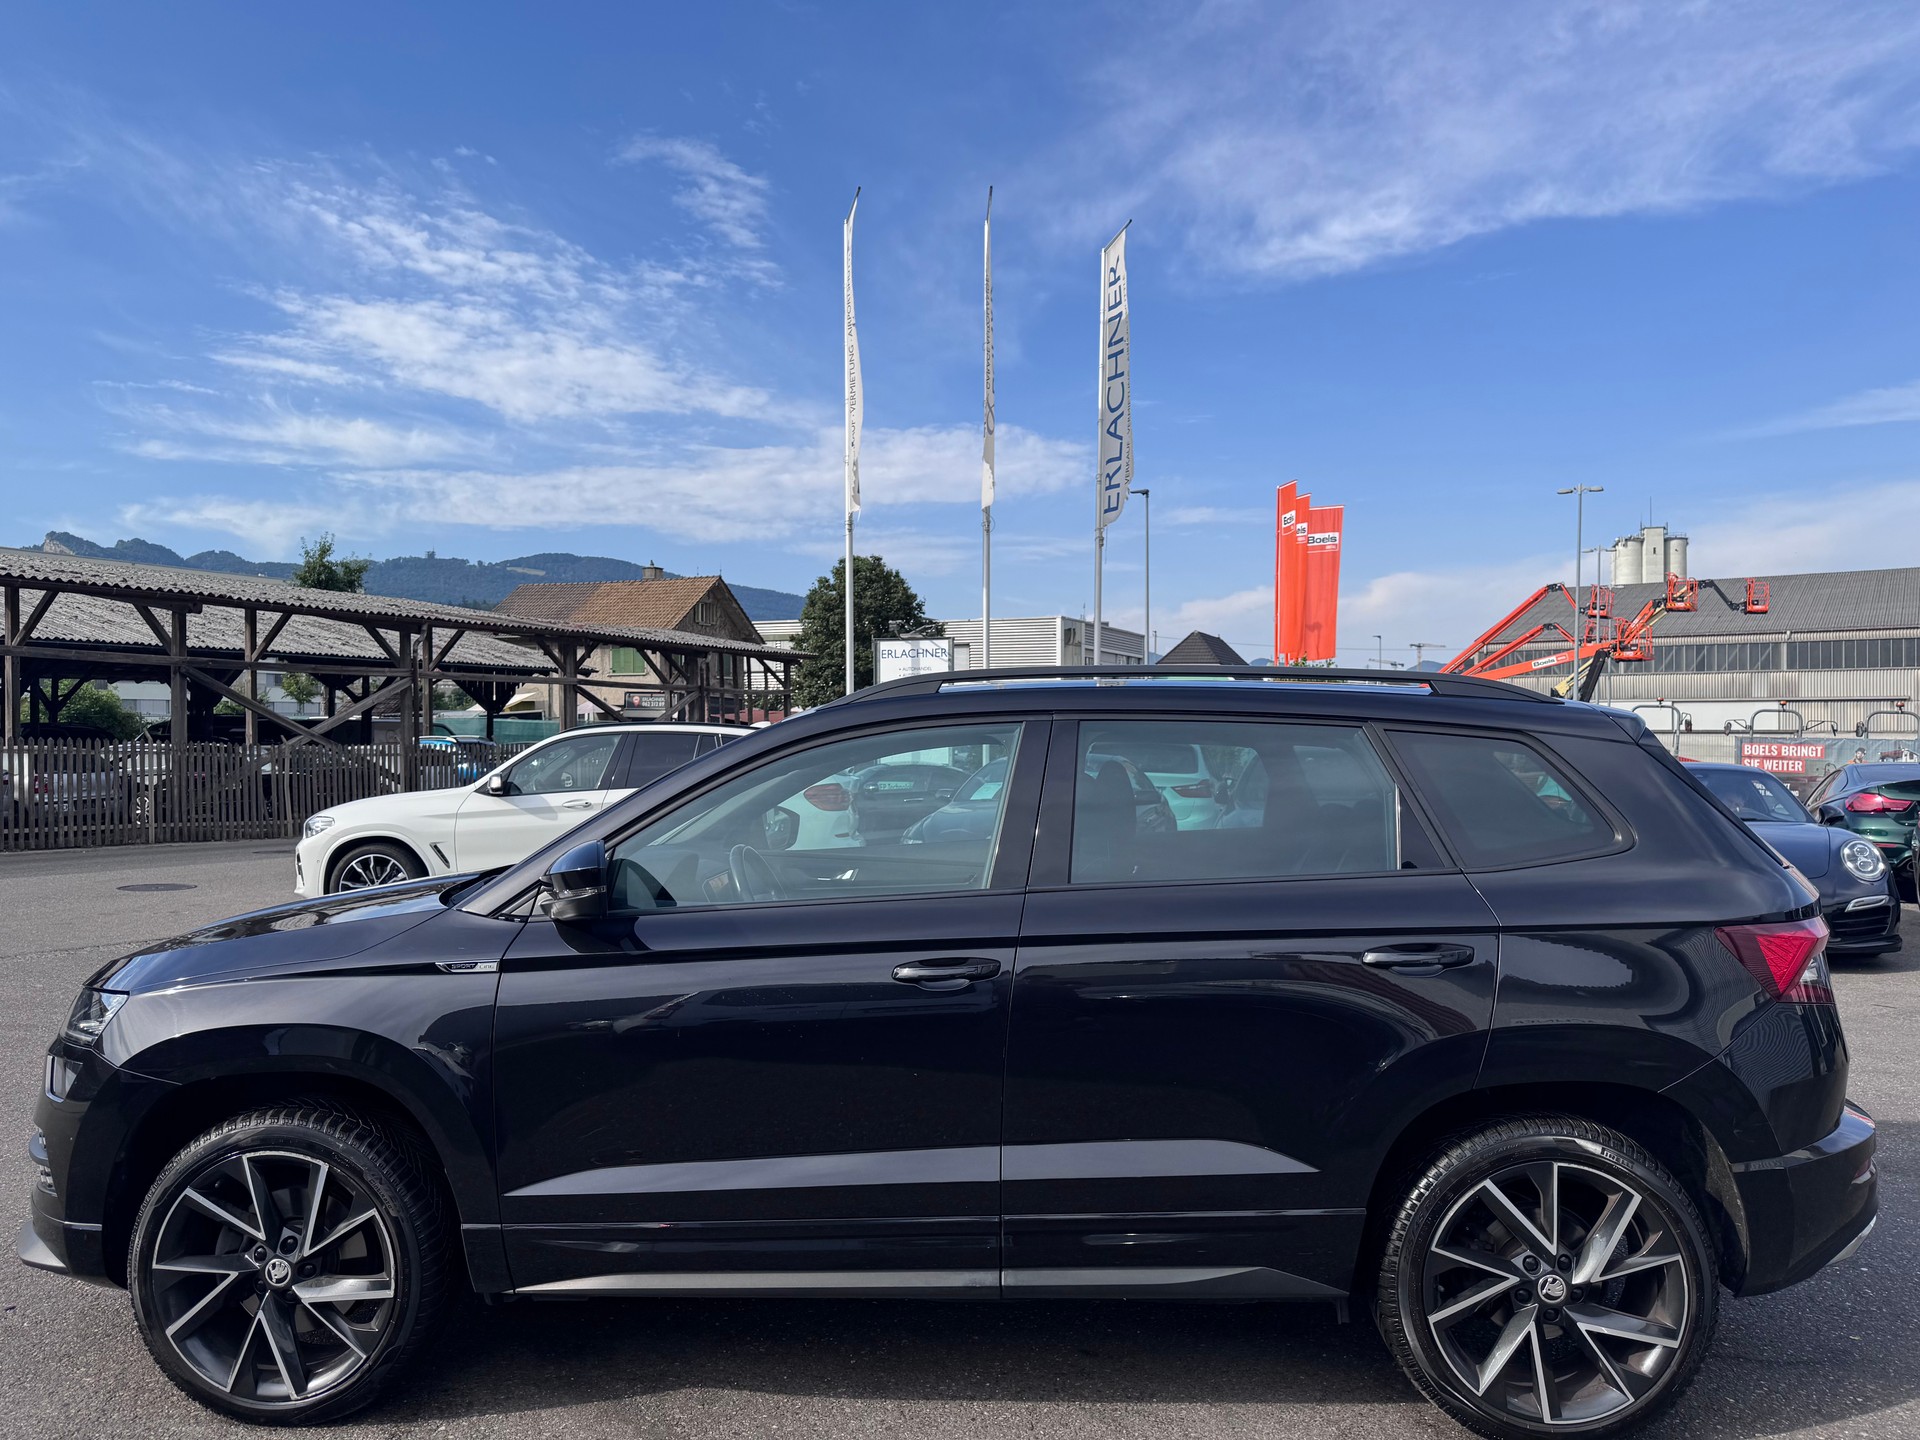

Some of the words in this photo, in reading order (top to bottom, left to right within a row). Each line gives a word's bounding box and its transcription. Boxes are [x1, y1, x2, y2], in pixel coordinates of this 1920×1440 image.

[1104, 254, 1126, 514] ERLACHNER
[1308, 535, 1337, 544] Boels
[881, 648, 948, 659] ERLACHNER
[1744, 744, 1778, 755] BOELS
[1781, 745, 1823, 757] BRINGT
[1763, 760, 1803, 771] WEITER
